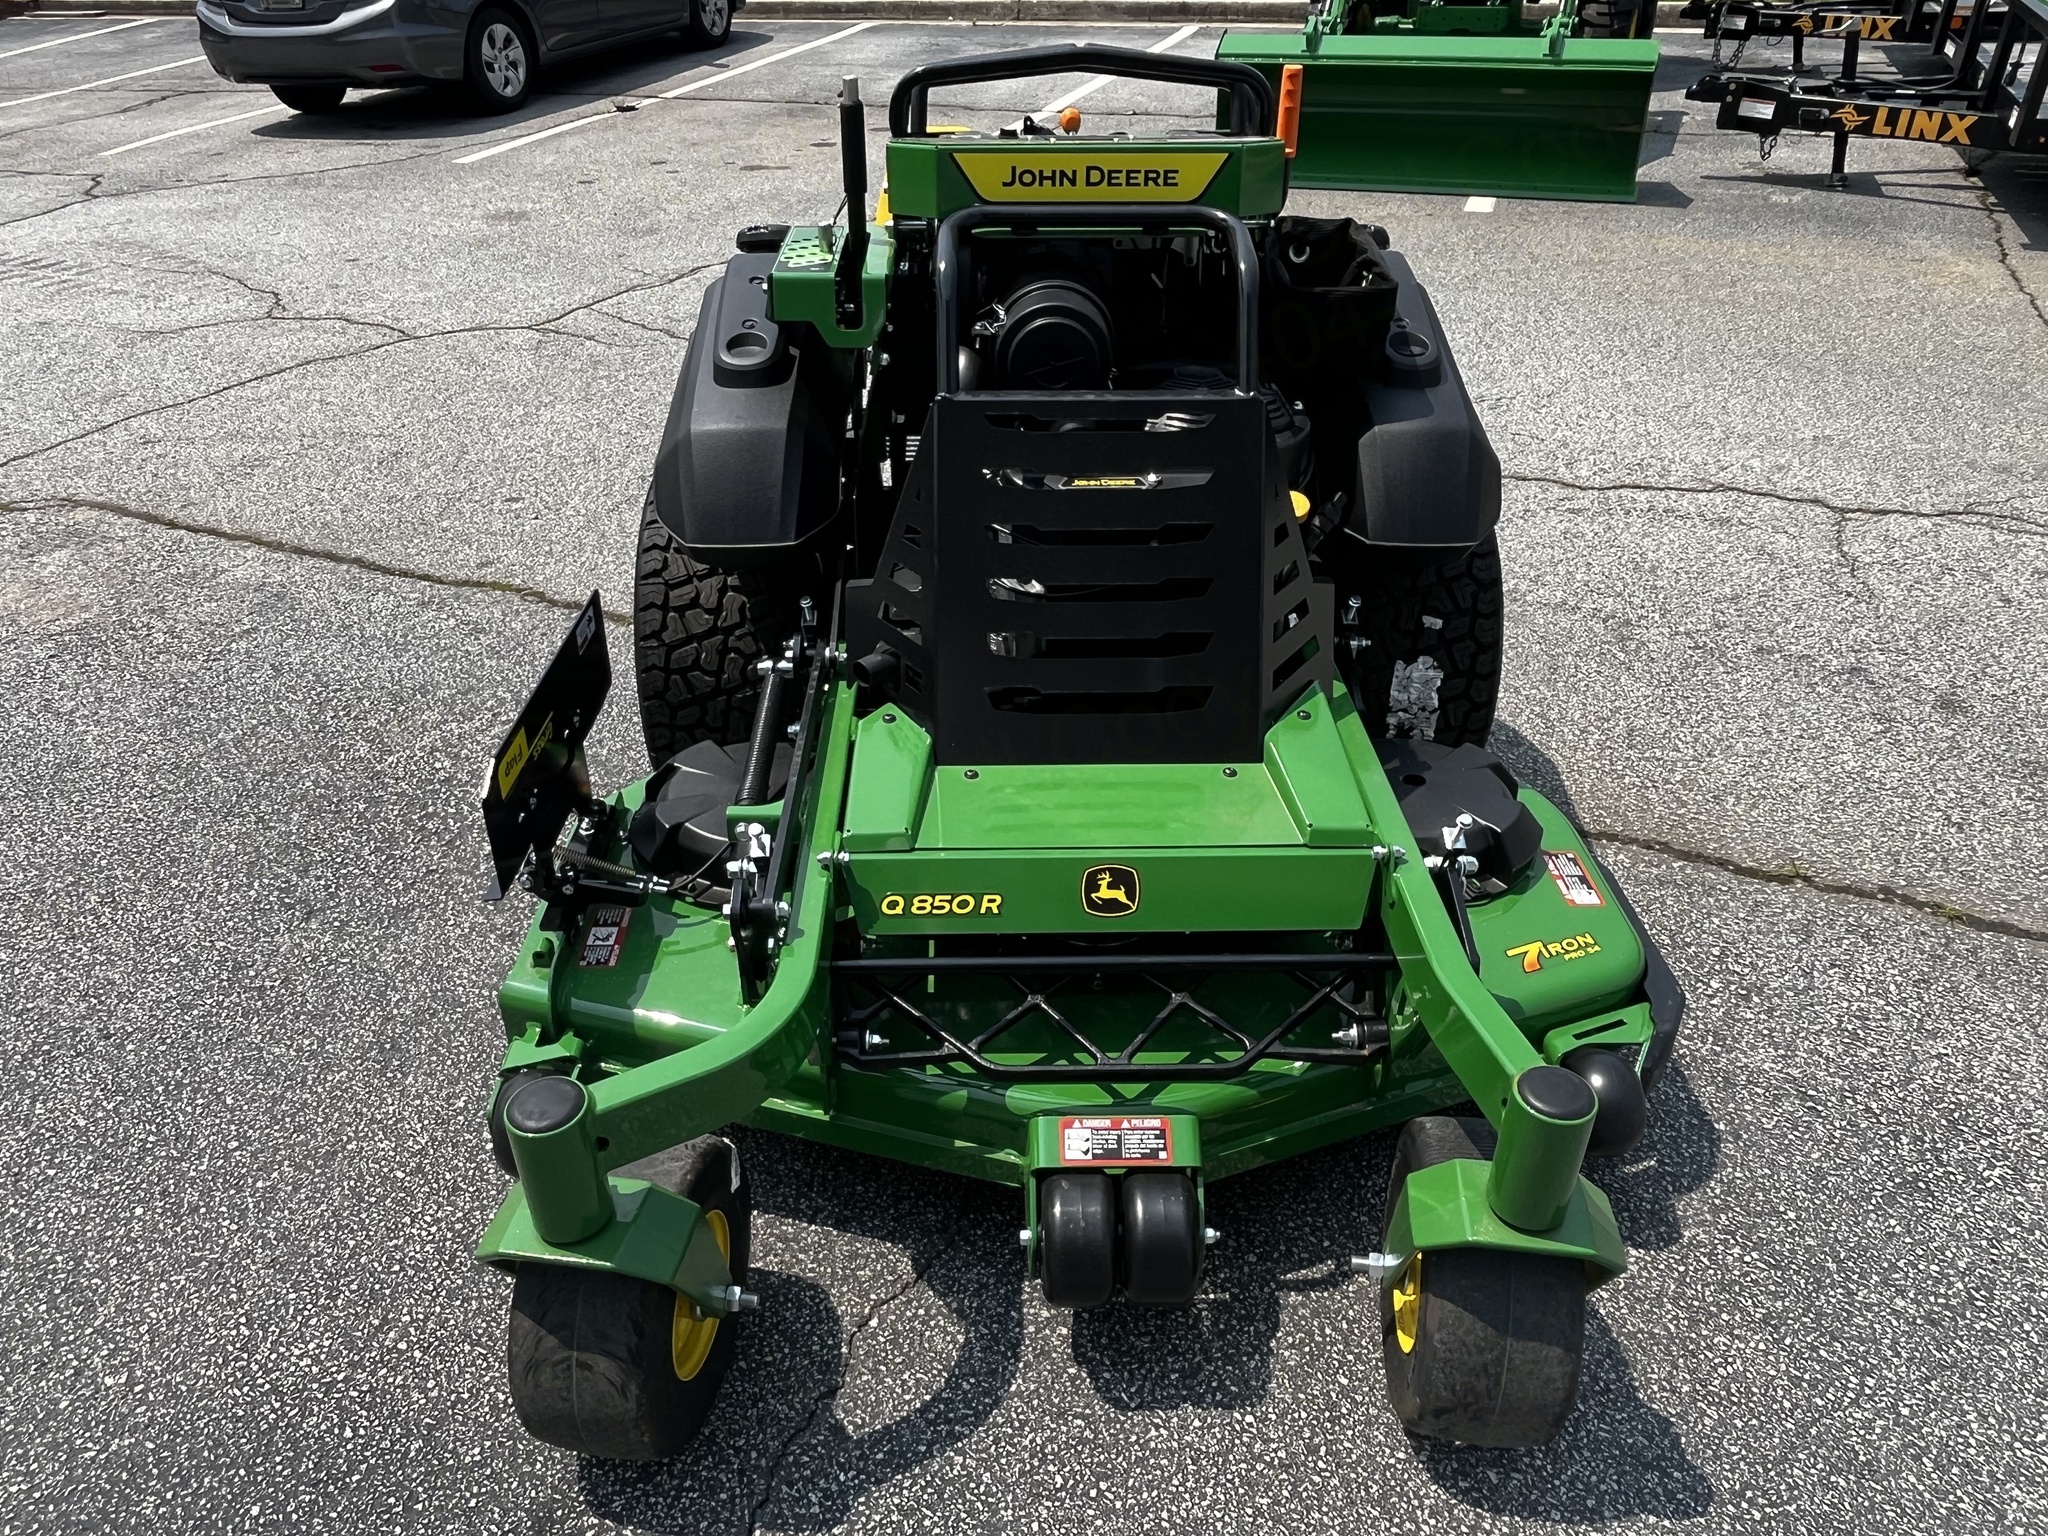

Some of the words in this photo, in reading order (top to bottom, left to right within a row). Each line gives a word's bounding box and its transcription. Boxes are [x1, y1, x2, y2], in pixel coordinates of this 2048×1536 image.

[1871, 106, 1979, 145] LINX
[1001, 165, 1078, 188] JOHN
[1084, 165, 1180, 188] DEERE
[504, 743, 524, 778] Flap
[880, 894, 905, 915] Q
[910, 894, 976, 915] 850
[979, 893, 1003, 915] R
